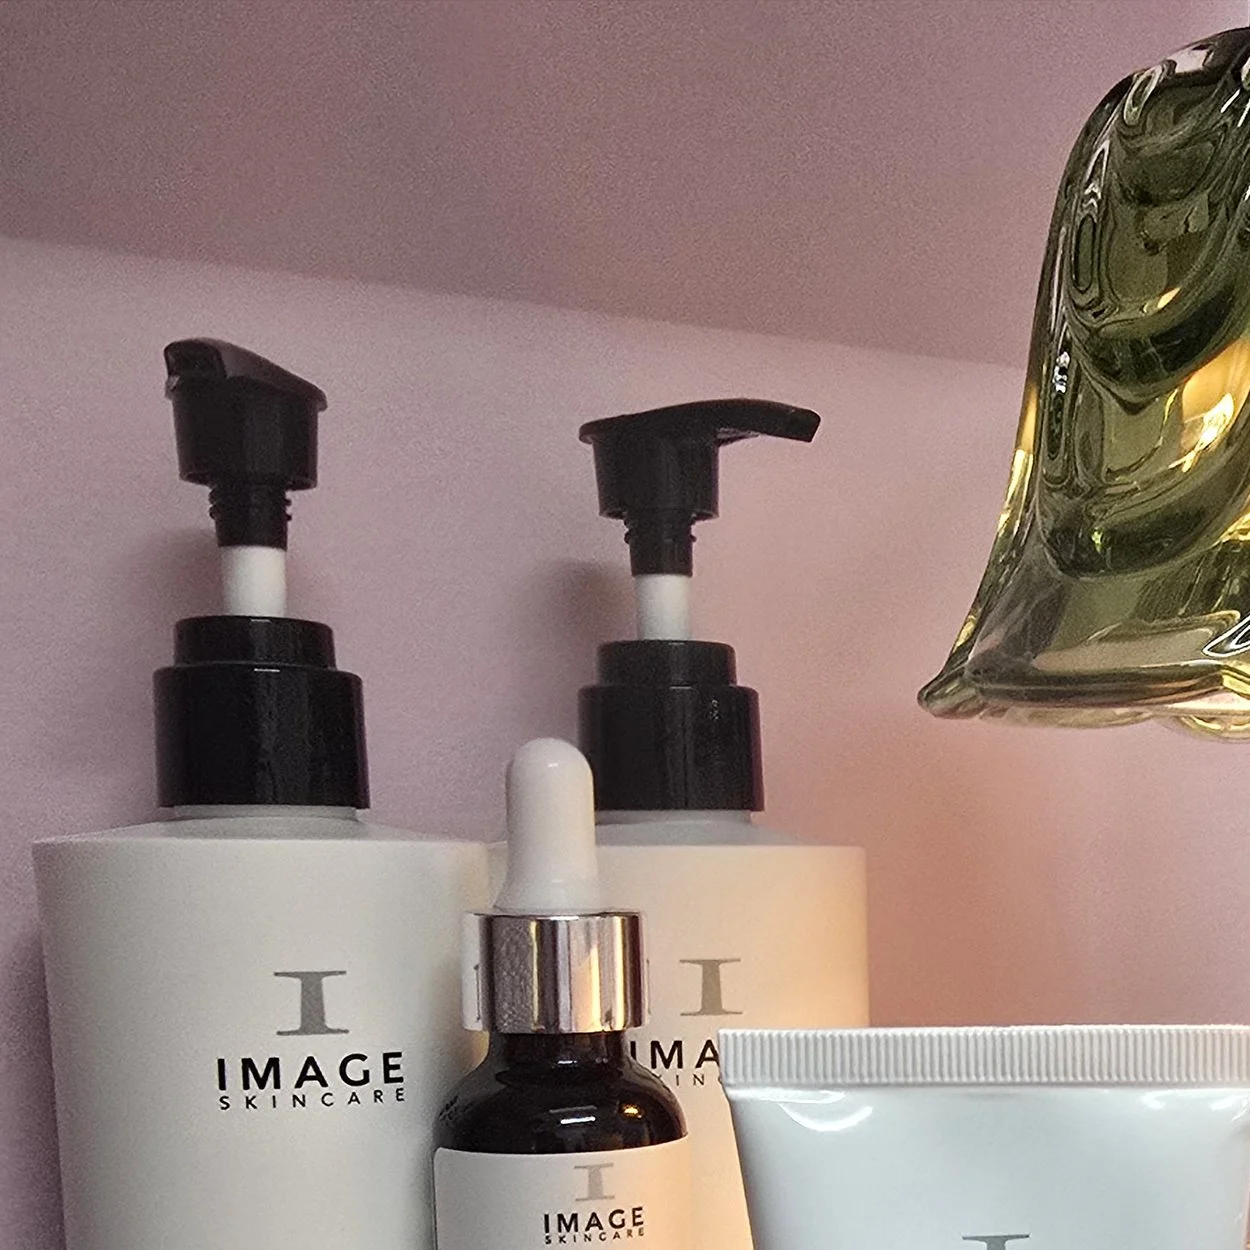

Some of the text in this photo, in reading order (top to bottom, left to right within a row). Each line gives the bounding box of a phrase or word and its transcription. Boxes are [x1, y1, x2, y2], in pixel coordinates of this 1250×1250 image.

[217, 1051, 405, 1091] IMAGE
[219, 1087, 406, 1111] SKINCARE
[543, 1206, 645, 1234] IMAGE
[545, 1227, 645, 1245] SKINCARE
